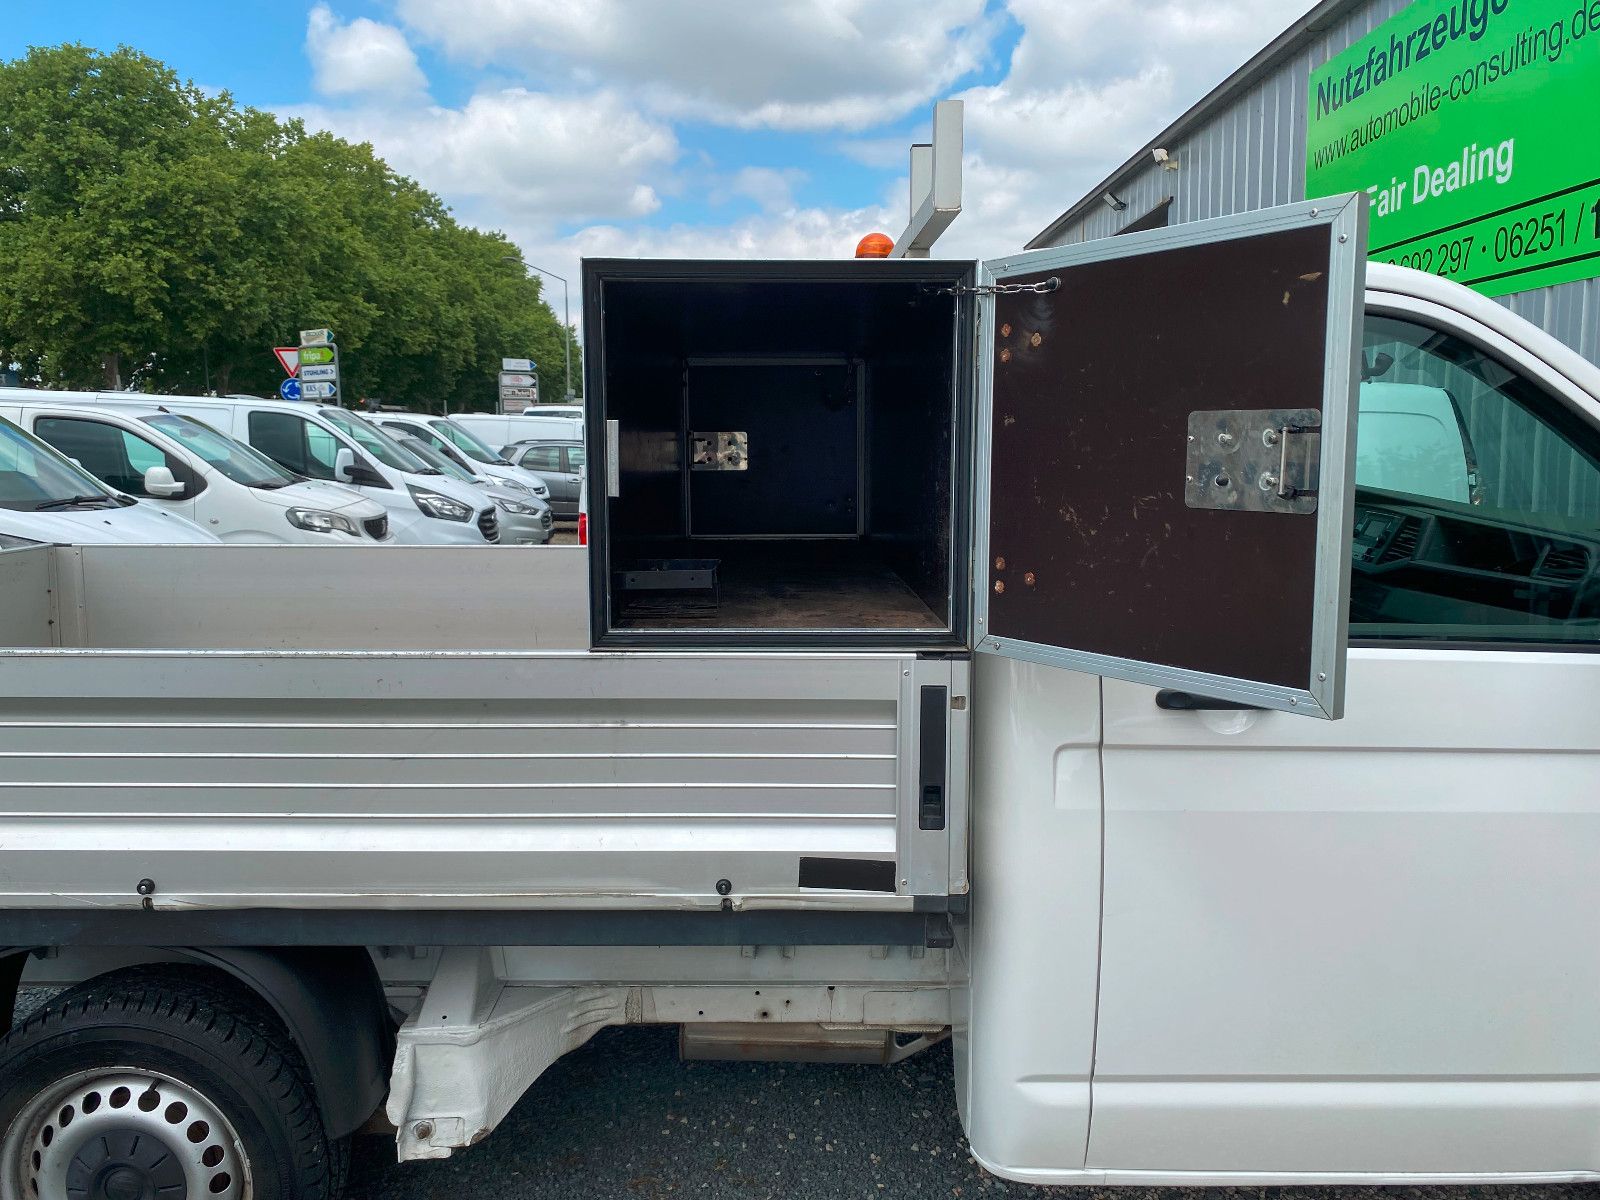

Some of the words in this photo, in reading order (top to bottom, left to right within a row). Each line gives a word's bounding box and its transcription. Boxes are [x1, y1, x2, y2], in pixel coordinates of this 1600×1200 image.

[1367, 177, 1406, 218] Fair
[1412, 138, 1515, 206] Dealing
[1437, 236, 1474, 276] 297
[1494, 208, 1566, 263] 06251
